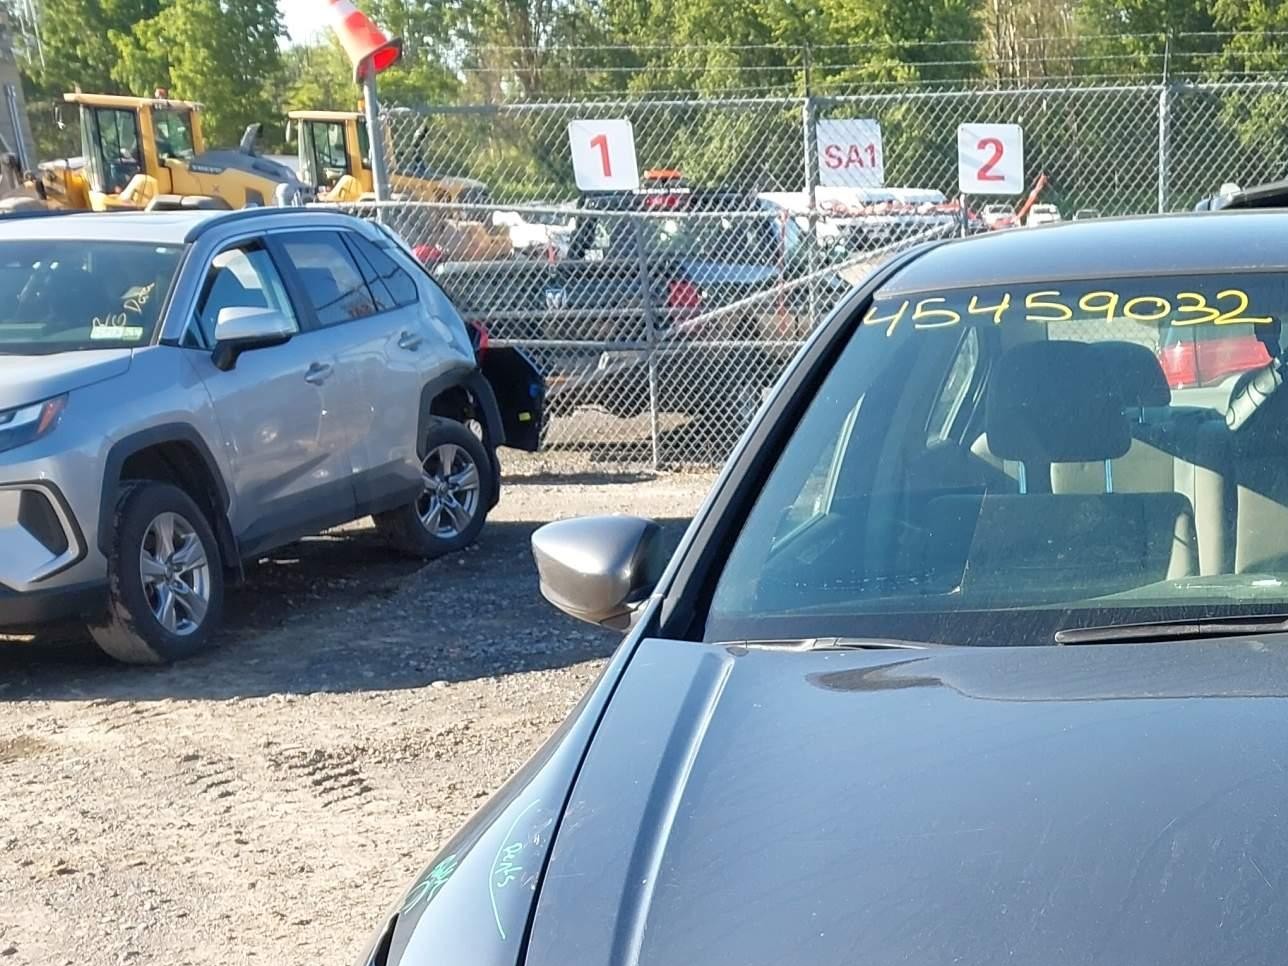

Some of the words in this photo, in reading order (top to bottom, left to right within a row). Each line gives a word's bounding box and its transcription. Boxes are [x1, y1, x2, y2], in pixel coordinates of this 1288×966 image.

[590, 134, 612, 177] 1
[824, 143, 877, 169] SA1
[976, 137, 1006, 182] 2
[863, 289, 1273, 336] 45459032
